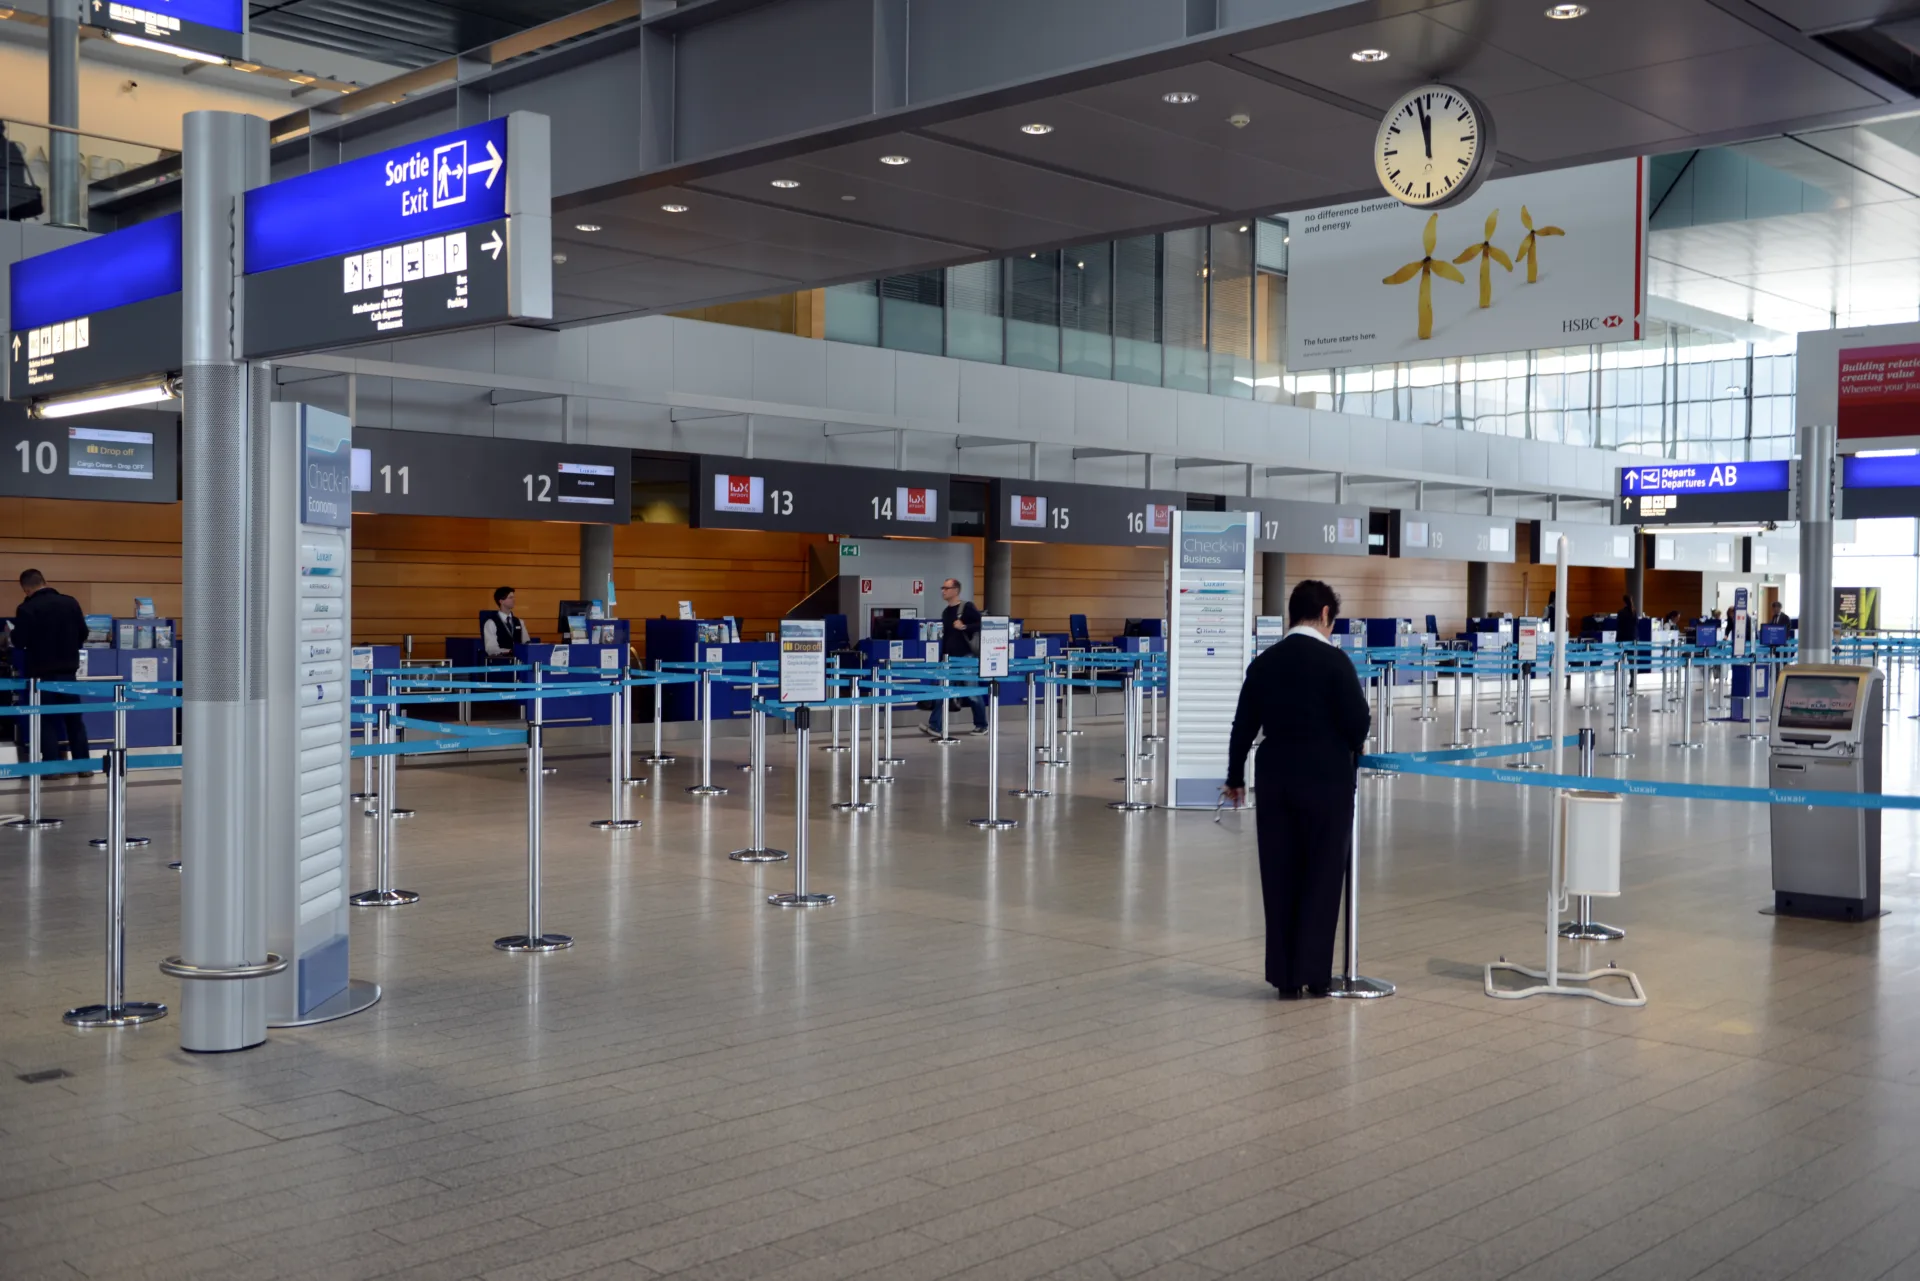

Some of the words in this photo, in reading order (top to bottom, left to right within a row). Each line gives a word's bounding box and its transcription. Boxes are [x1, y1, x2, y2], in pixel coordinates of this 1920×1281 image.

[385, 152, 429, 186] Sortie
[402, 187, 428, 216] Exit
[1304, 214, 1315, 222] no
[1317, 207, 1359, 220] difference
[1361, 201, 1399, 214] between
[1304, 224, 1320, 234] and
[1321, 220, 1352, 231] energy.
[1562, 317, 1600, 333] HSBC
[1304, 338, 1316, 346] The
[1317, 337, 1337, 345] future
[1338, 335, 1359, 343] starts
[1842, 361, 1885, 373] Building
[1841, 371, 1884, 382] creating
[1887, 369, 1915, 379] value
[1841, 384, 1881, 394] Wherever
[1884, 383, 1904, 394] your
[15, 440, 58, 475] 10
[100, 446, 121, 457] Drop
[122, 446, 134, 456] off
[77, 460, 94, 469] Cargo
[95, 461, 113, 469] Crews
[117, 463, 131, 471] Drop
[308, 463, 350, 494] Check-in
[380, 465, 409, 495] 11
[1661, 467, 1696, 480] Départs
[1708, 465, 1737, 487] AB
[522, 474, 551, 502] 12
[730, 482, 749, 493] lux
[1661, 479, 1706, 491] Departures
[308, 496, 338, 519] Economy
[770, 490, 794, 515] 13
[871, 497, 893, 520] 14
[1052, 508, 1070, 530] 15
[1127, 512, 1143, 533] 16
[1264, 521, 1279, 540] 17
[1323, 525, 1336, 544] 18
[1183, 538, 1245, 553] Check-in
[1432, 532, 1443, 549] 19
[1477, 534, 1488, 551] 20
[316, 551, 333, 562] Luxair
[1183, 554, 1221, 564] Business
[794, 643, 811, 653] Drop
[812, 642, 821, 651] off
[439, 741, 460, 750] Luxair
[1497, 773, 1523, 783] Luxair
[1629, 785, 1657, 794] Luxair
[1775, 793, 1806, 803] Luxair
